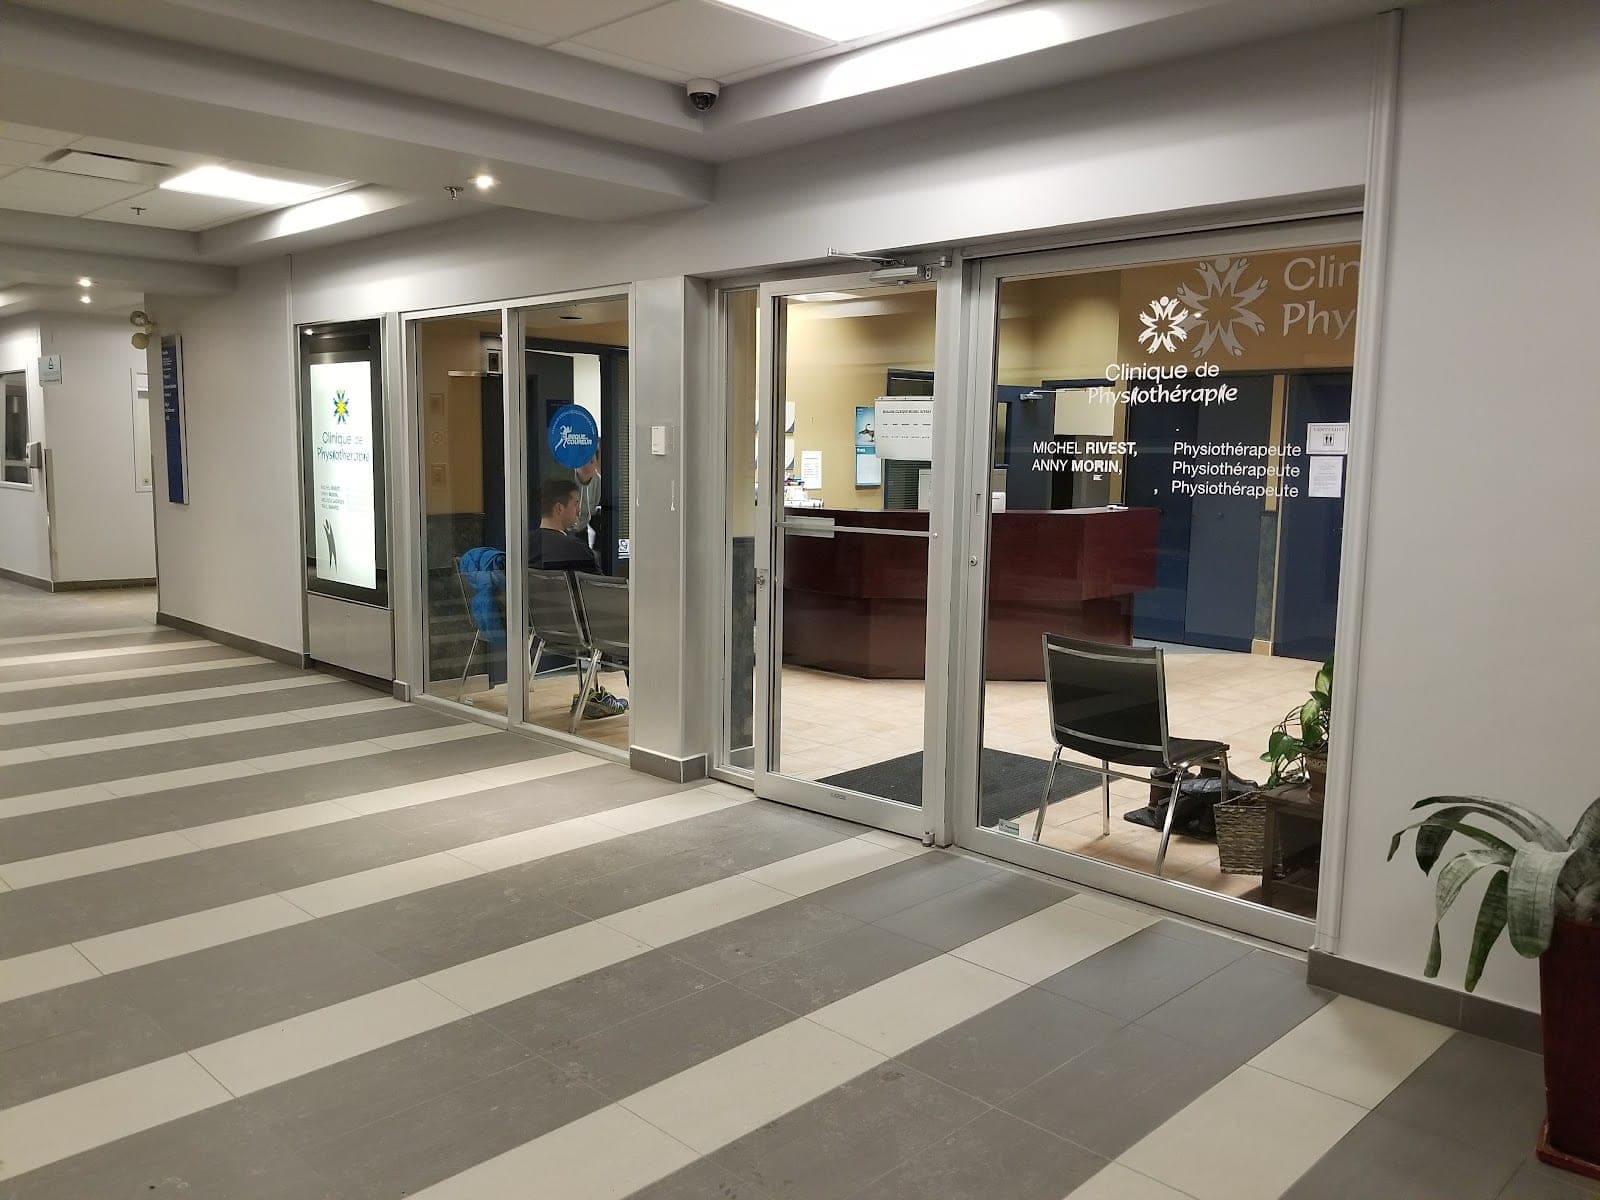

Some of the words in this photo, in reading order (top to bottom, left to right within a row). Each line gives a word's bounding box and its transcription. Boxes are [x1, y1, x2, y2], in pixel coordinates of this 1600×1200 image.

[1281, 299, 1356, 341] Phy
[1105, 362, 1188, 384] Clinique
[1195, 361, 1220, 378] de
[1087, 383, 1239, 408] Physiothérapie
[1032, 441, 1083, 455] MICHEL
[1085, 441, 1138, 458] RIVEST,
[1173, 441, 1302, 460] Physiothérapeute
[1031, 458, 1069, 472] ANNY
[1071, 460, 1123, 476] MORIN,
[1172, 460, 1301, 480] Physiothérapeute
[1171, 480, 1299, 499] Physiothérapeute
